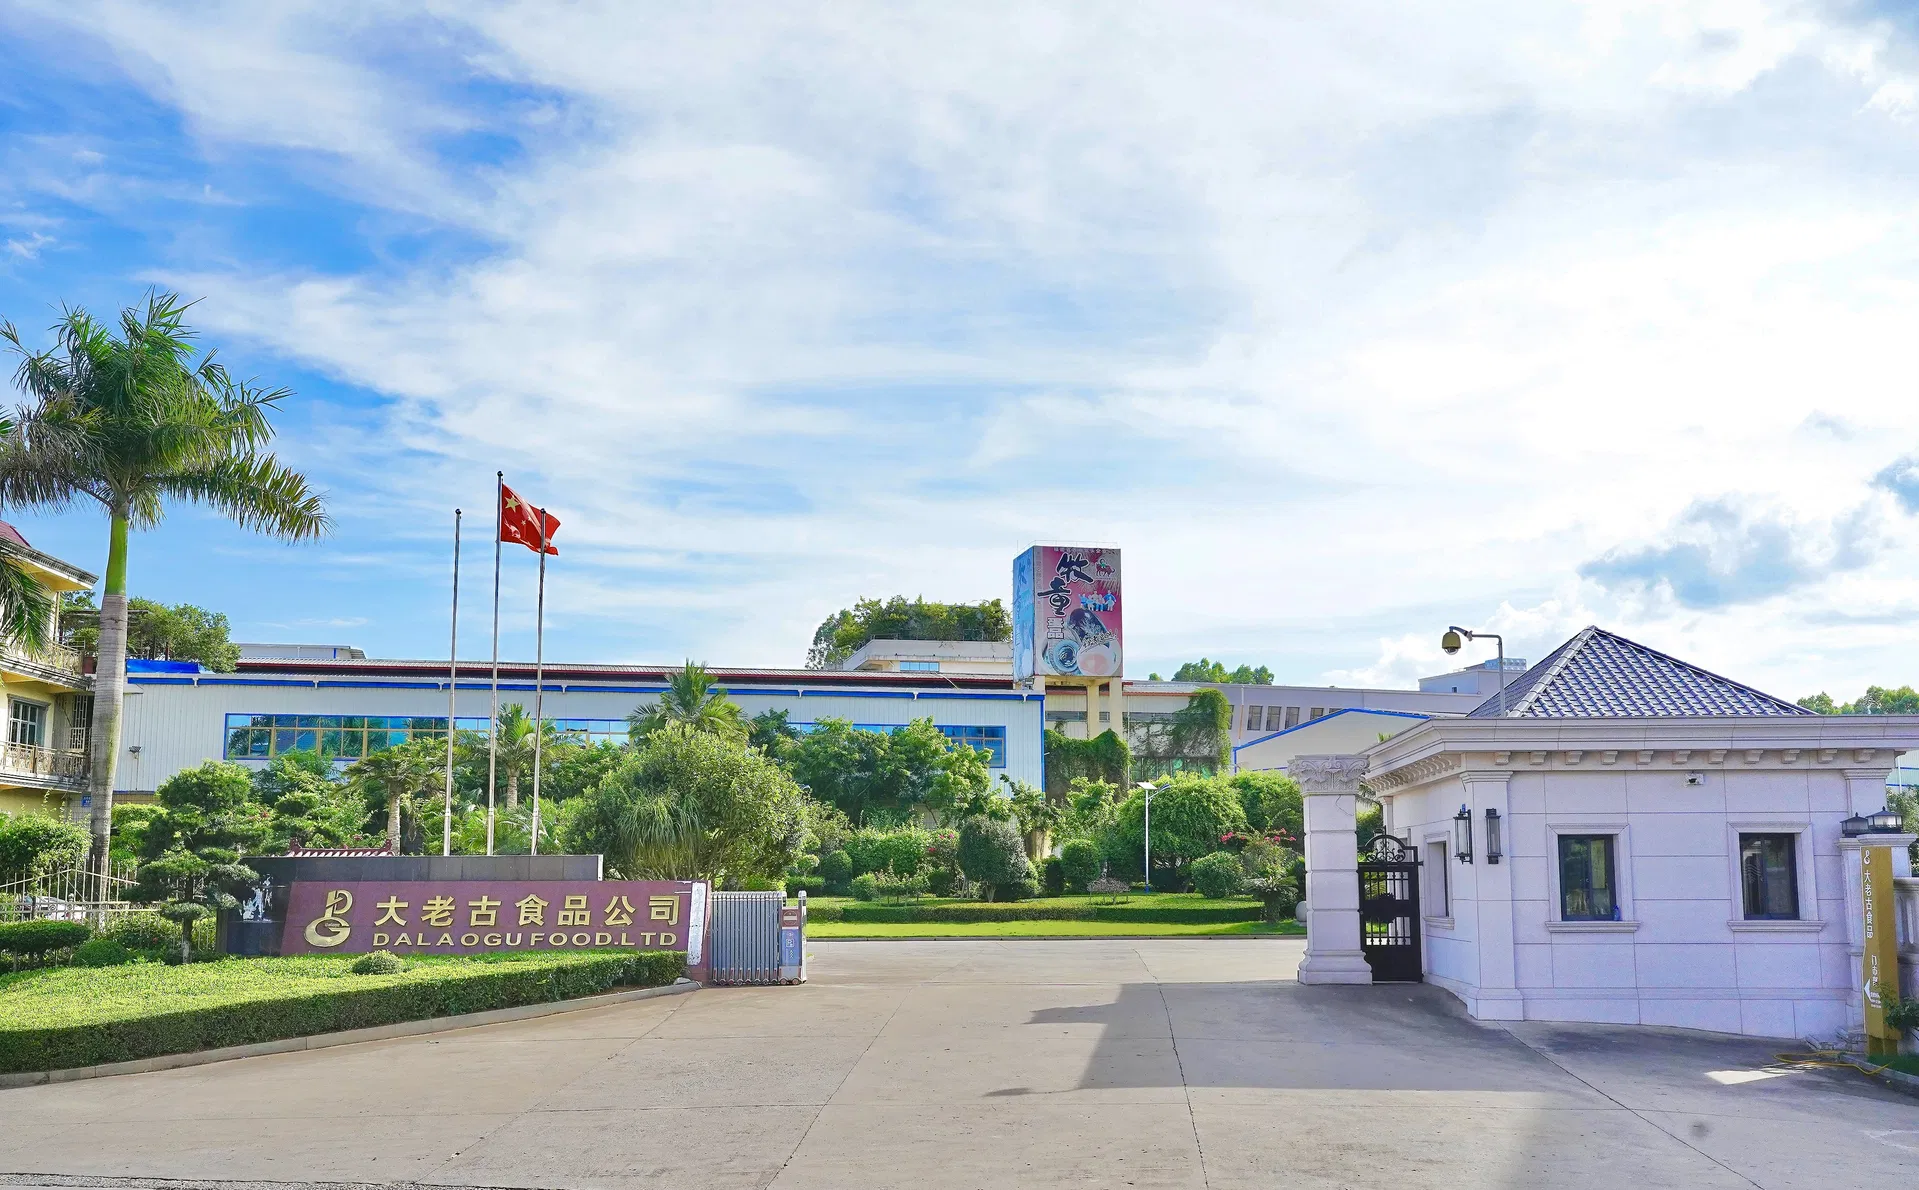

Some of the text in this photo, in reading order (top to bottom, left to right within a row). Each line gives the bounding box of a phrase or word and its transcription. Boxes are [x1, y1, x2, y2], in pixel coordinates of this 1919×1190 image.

[374, 894, 680, 927] 大老古食品公司
[1864, 869, 1874, 939] 大老古食品
[373, 932, 677, 946] DALAOGU FOOD.LTD
